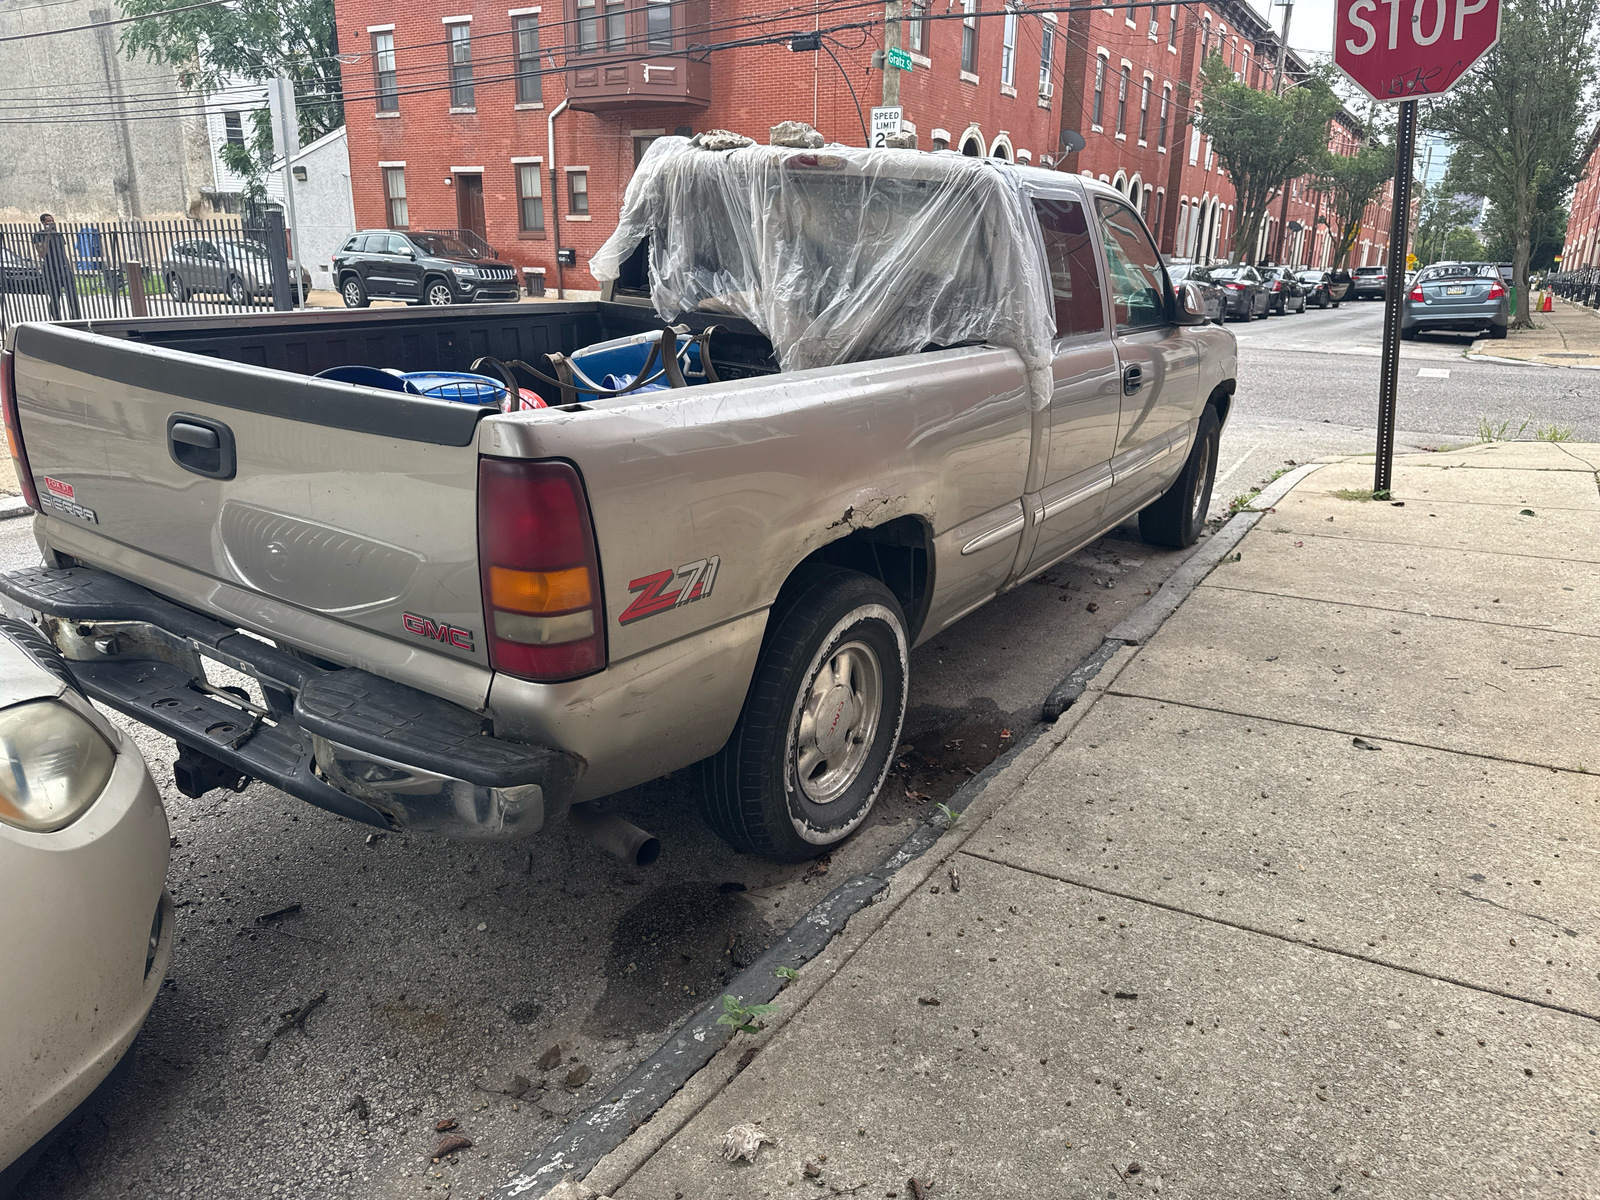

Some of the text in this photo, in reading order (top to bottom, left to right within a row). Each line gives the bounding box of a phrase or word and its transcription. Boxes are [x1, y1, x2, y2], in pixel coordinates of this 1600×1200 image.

[1345, 0, 1489, 56] STOP
[888, 52, 905, 68] Gratz
[906, 59, 913, 71] St
[874, 111, 899, 120] SPEED
[876, 121, 896, 130] LIMIT
[40, 491, 98, 524] SIERRA
[618, 554, 721, 627] Z71
[402, 611, 476, 652] GMC
[827, 700, 844, 739] GMC
